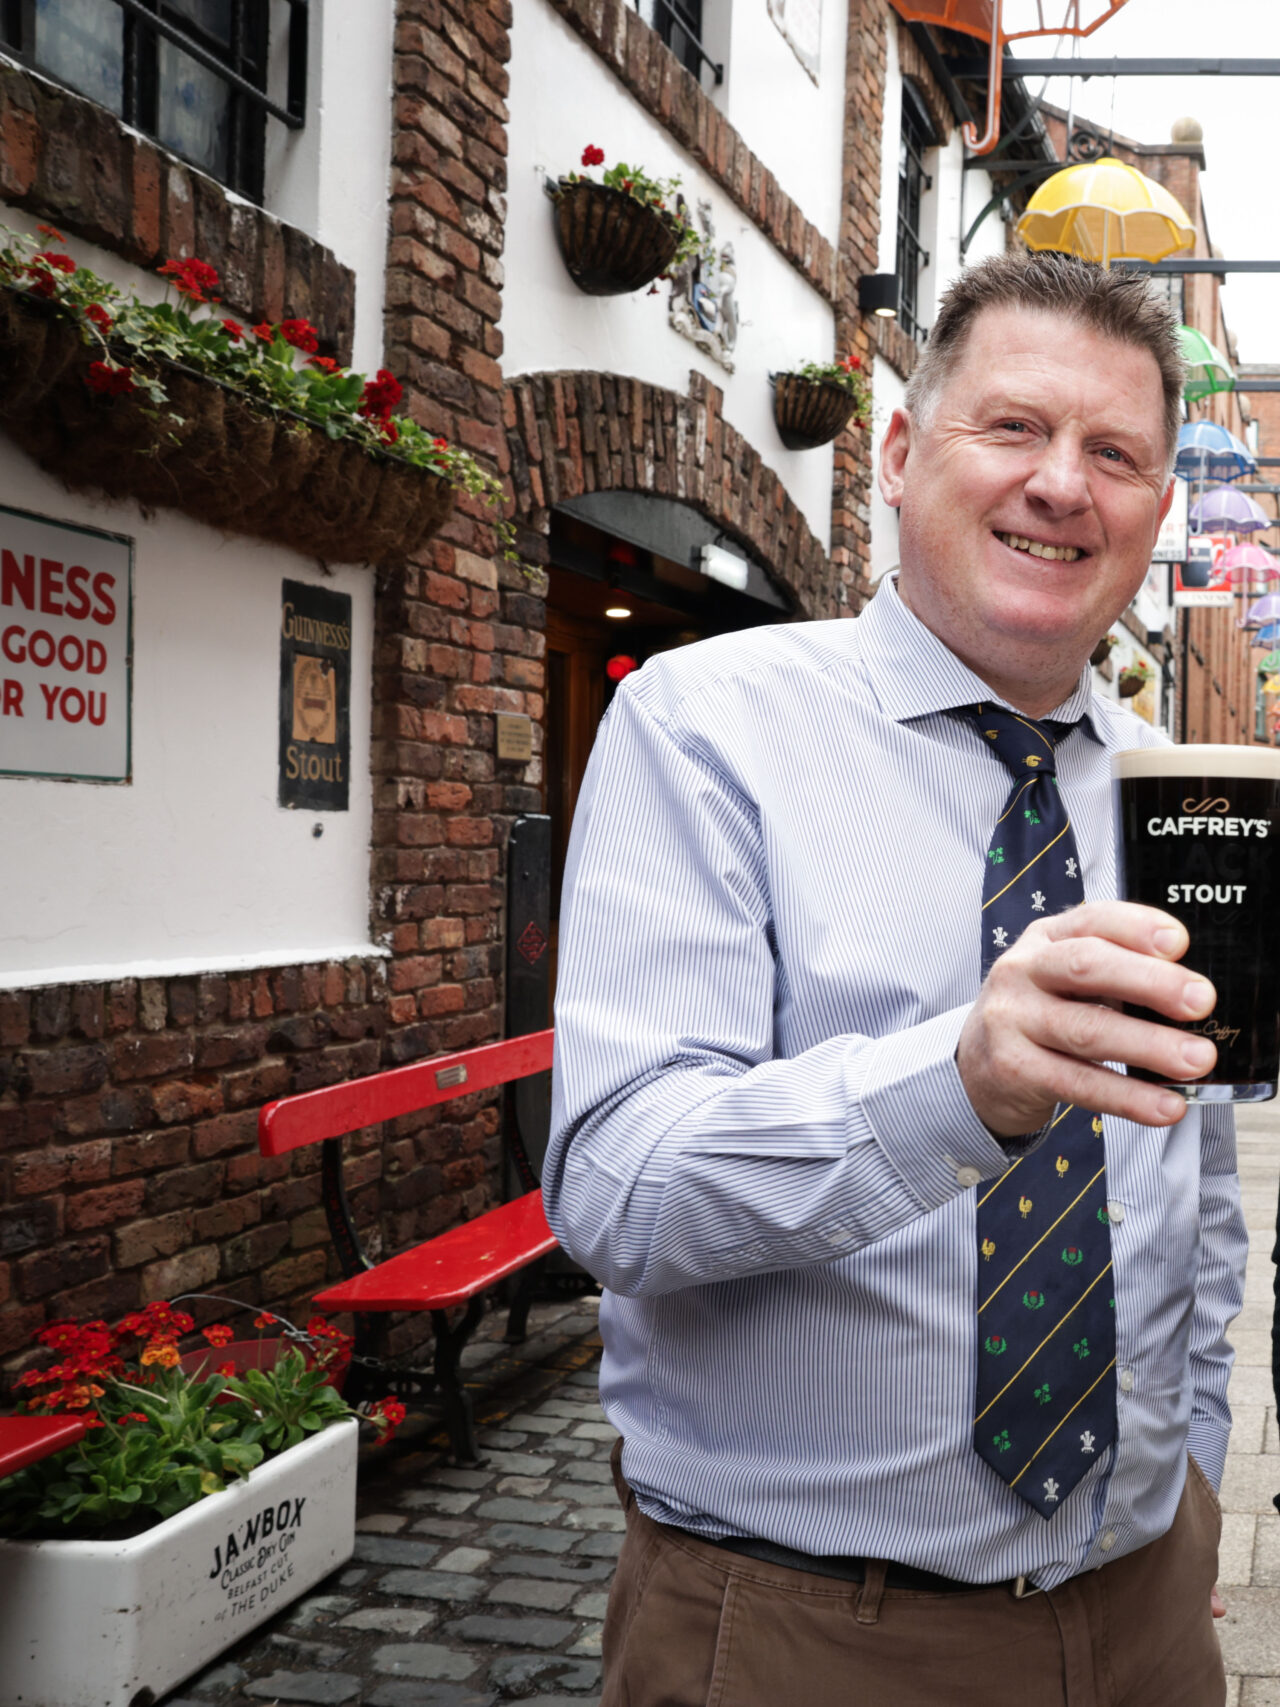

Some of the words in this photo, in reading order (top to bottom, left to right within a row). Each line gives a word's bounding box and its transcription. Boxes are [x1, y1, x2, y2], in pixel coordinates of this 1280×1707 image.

[1, 625, 107, 675] GOOD
[0, 679, 24, 717] R
[39, 683, 107, 726] YOU
[285, 746, 343, 783] Stout
[1147, 817, 1270, 839] CAFFREY'S
[1167, 884, 1247, 904] STOUT
[227, 1569, 268, 1600] BELFAST
[270, 1553, 288, 1574] CUT
[232, 1593, 255, 1617] THE
[260, 1562, 295, 1603] DUKE
